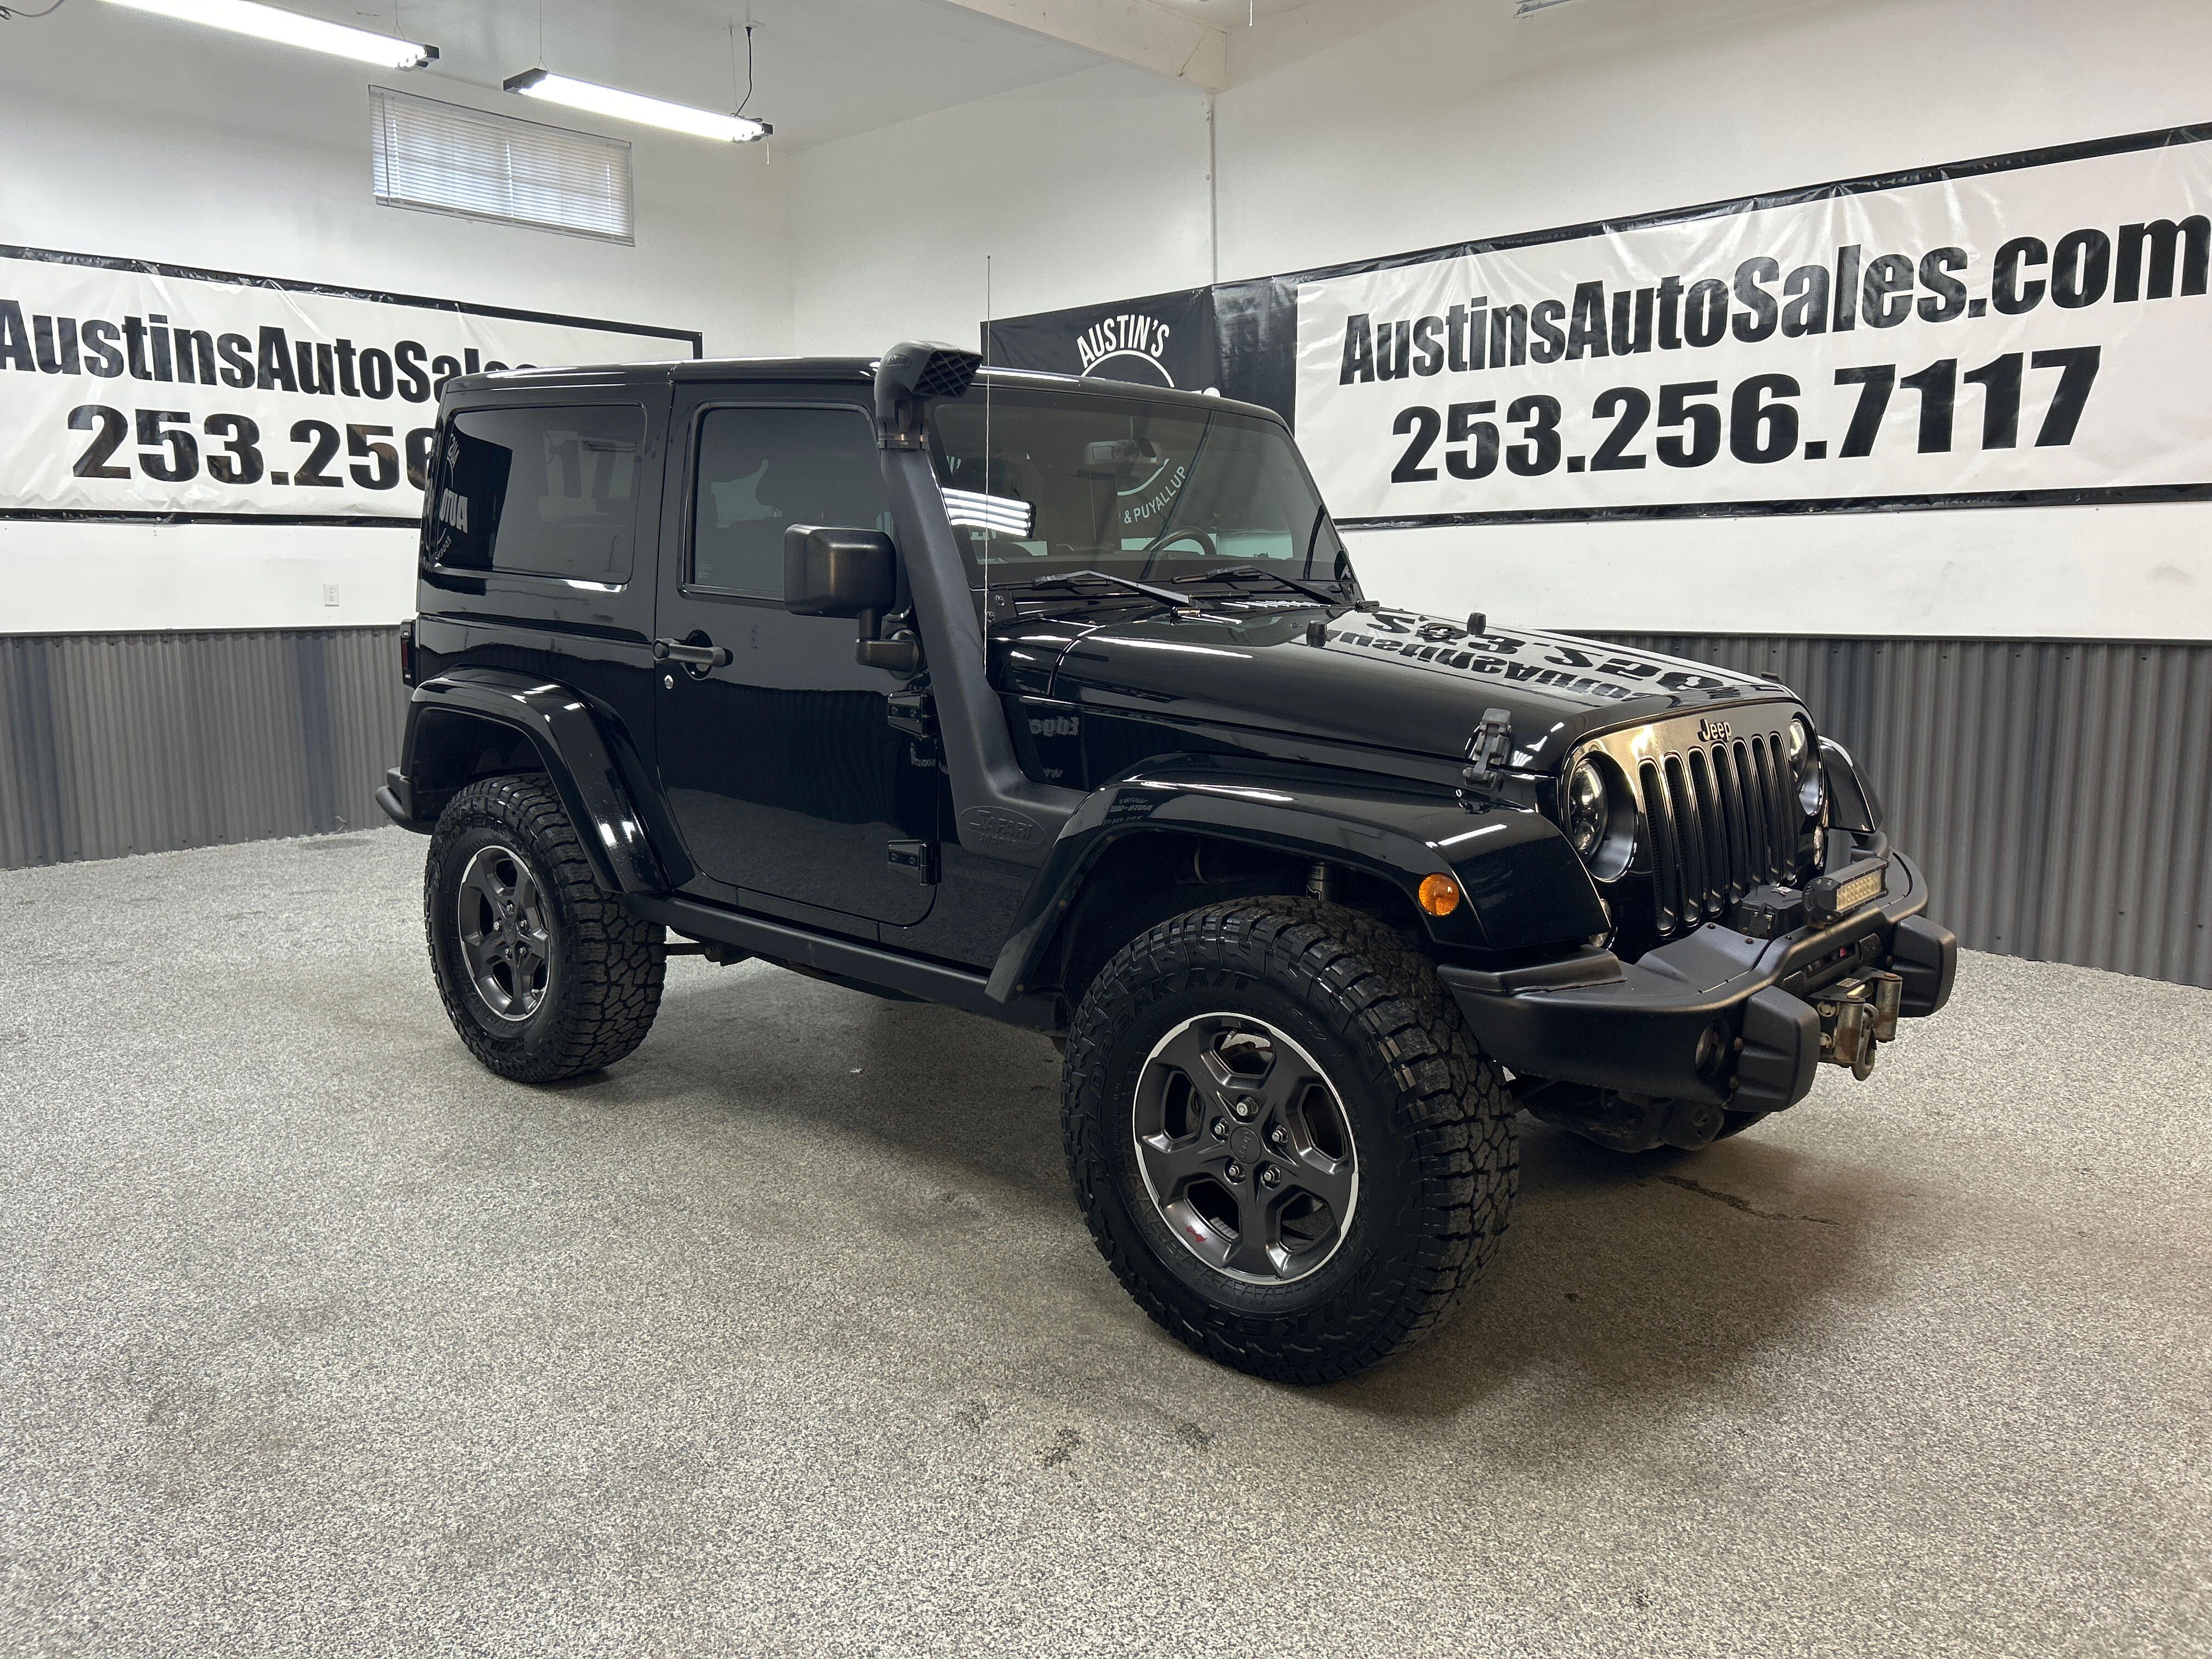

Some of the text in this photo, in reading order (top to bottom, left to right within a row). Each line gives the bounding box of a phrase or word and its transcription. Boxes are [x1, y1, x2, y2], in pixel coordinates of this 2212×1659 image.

[1339, 215, 2211, 386] AustinsAutoSales.com
[1076, 314, 1170, 369] AUSTIN'S
[1391, 345, 2102, 484] 253.256.7117
[1124, 465, 1186, 524] & PUYALLUP
[1697, 719, 1732, 742] Jeep
[968, 809, 1034, 840] SAFARI
